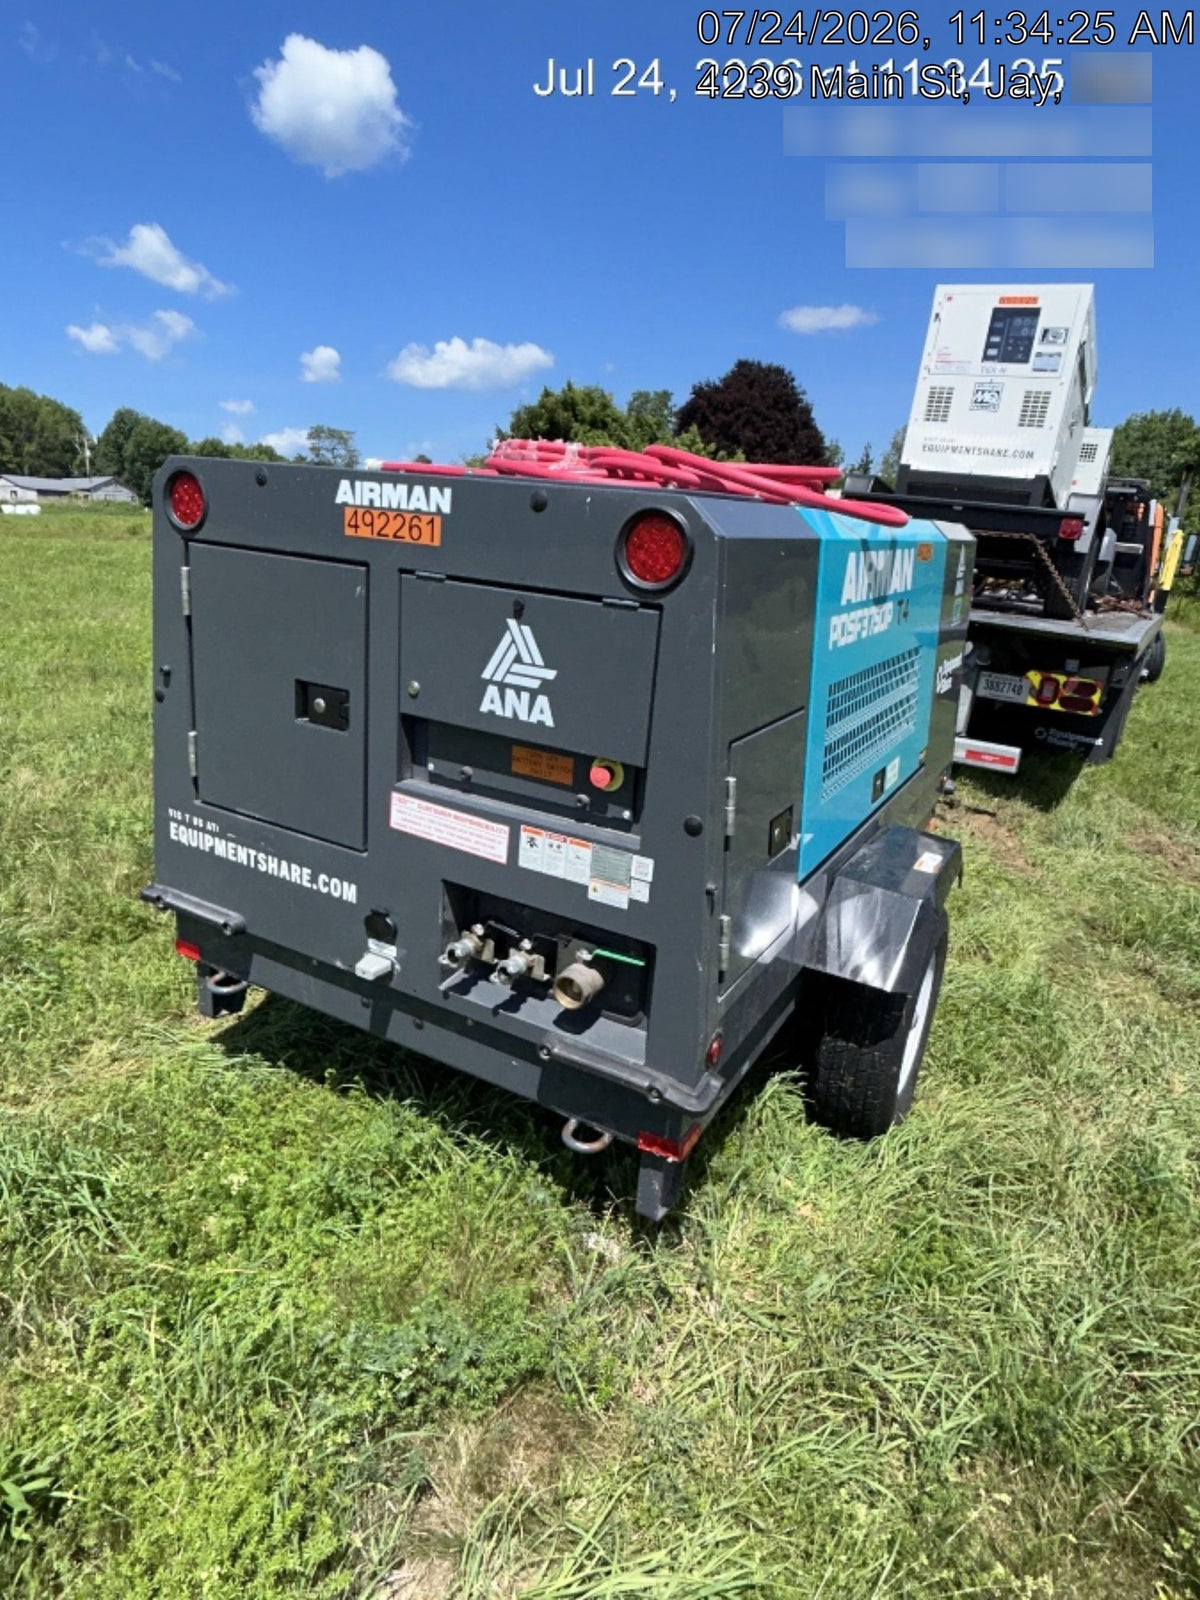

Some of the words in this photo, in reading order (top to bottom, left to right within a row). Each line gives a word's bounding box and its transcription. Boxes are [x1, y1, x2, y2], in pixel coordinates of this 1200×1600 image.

[335, 479, 452, 514] AIRMAN
[347, 509, 435, 543] 492261
[840, 547, 915, 607] AIRMAN
[479, 684, 555, 728] ANA
[168, 808, 190, 823] VIST
[169, 821, 357, 904] EQUIPMENTSHARE.COM
